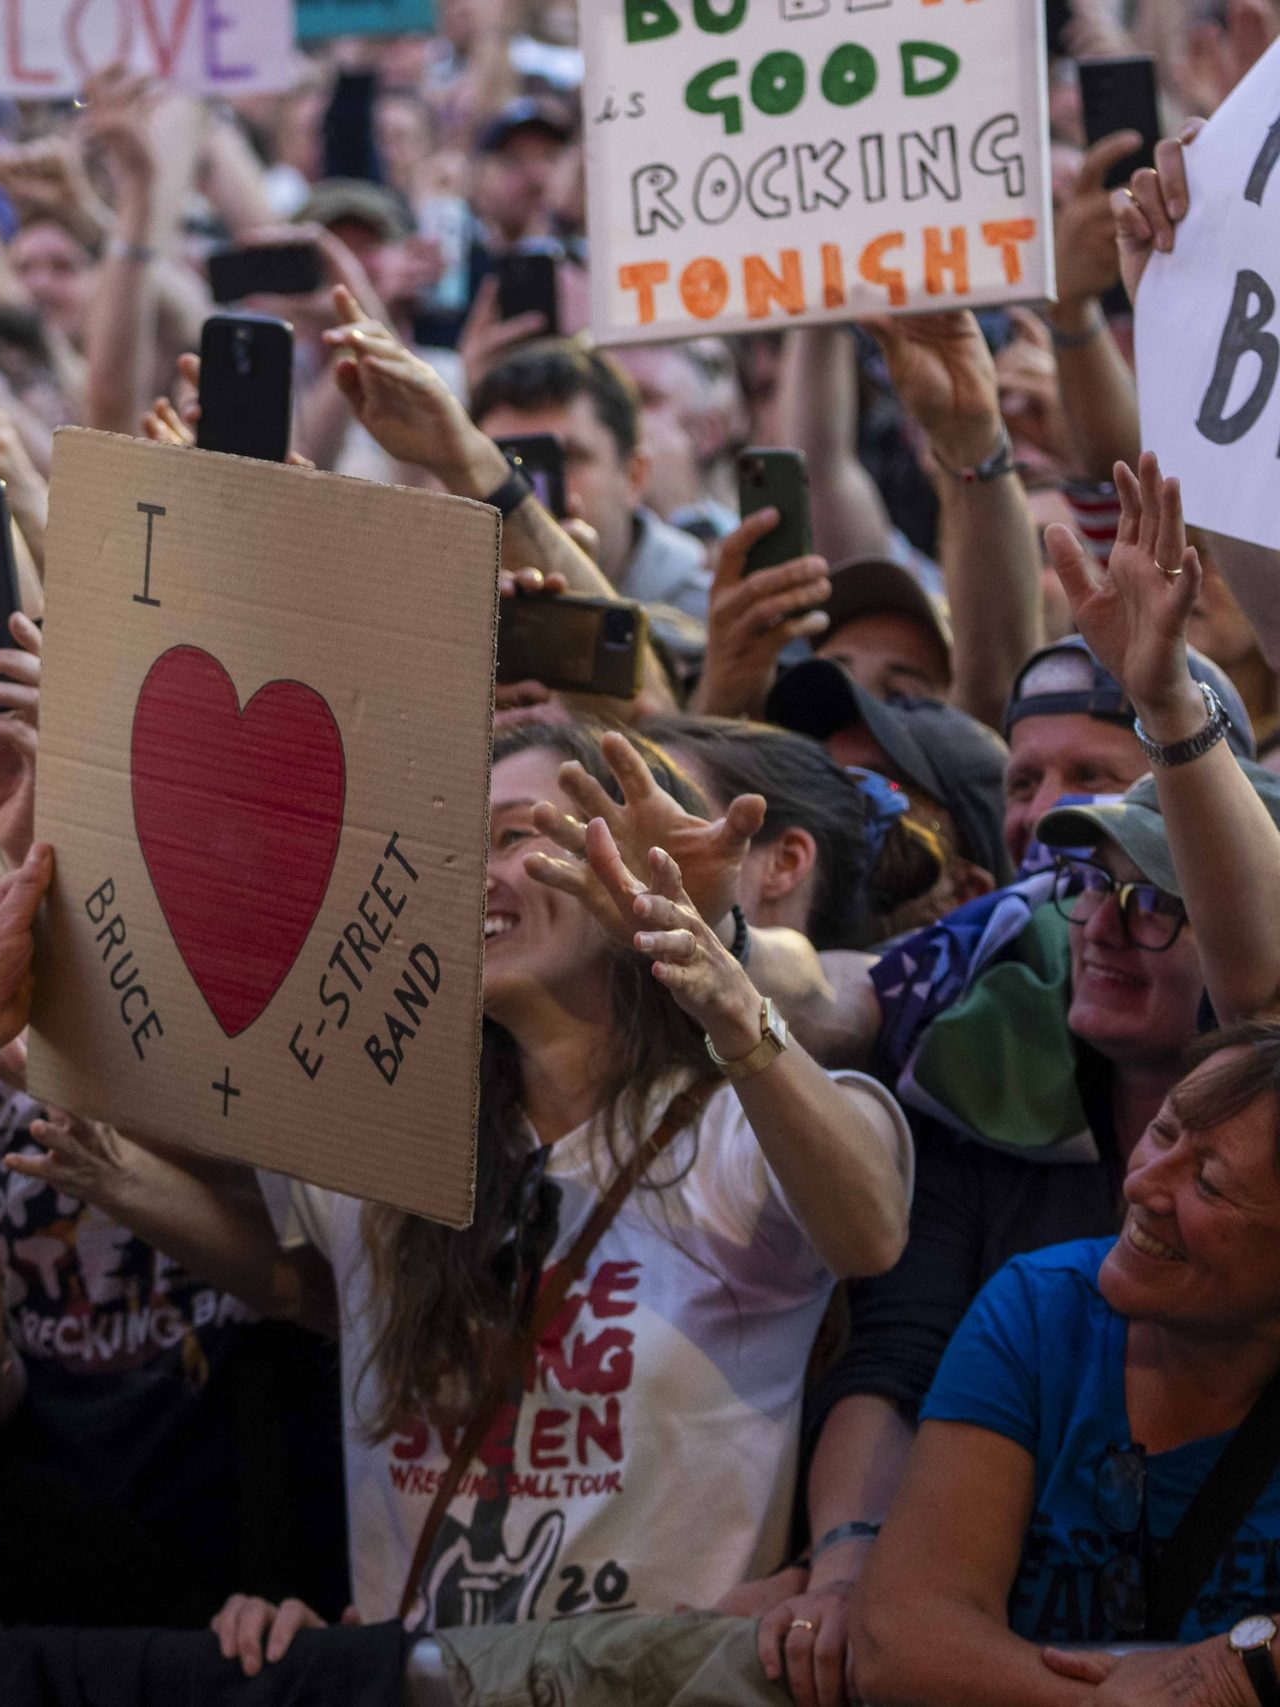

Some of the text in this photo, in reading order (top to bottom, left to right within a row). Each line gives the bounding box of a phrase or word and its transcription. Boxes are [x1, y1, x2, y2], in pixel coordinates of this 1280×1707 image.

[3, 0, 255, 82] LOVE
[594, 40, 961, 135] is GOOD
[631, 112, 1025, 236] ROCKING
[618, 217, 1037, 325] TONIGHT
[84, 877, 164, 1062] BRUCE
[289, 831, 420, 1081] E-STREET
[363, 942, 443, 1086] BAND
[6, 1304, 186, 1361] RECKING
[562, 1471, 624, 1497] TOUR
[556, 1560, 630, 1613] 20
